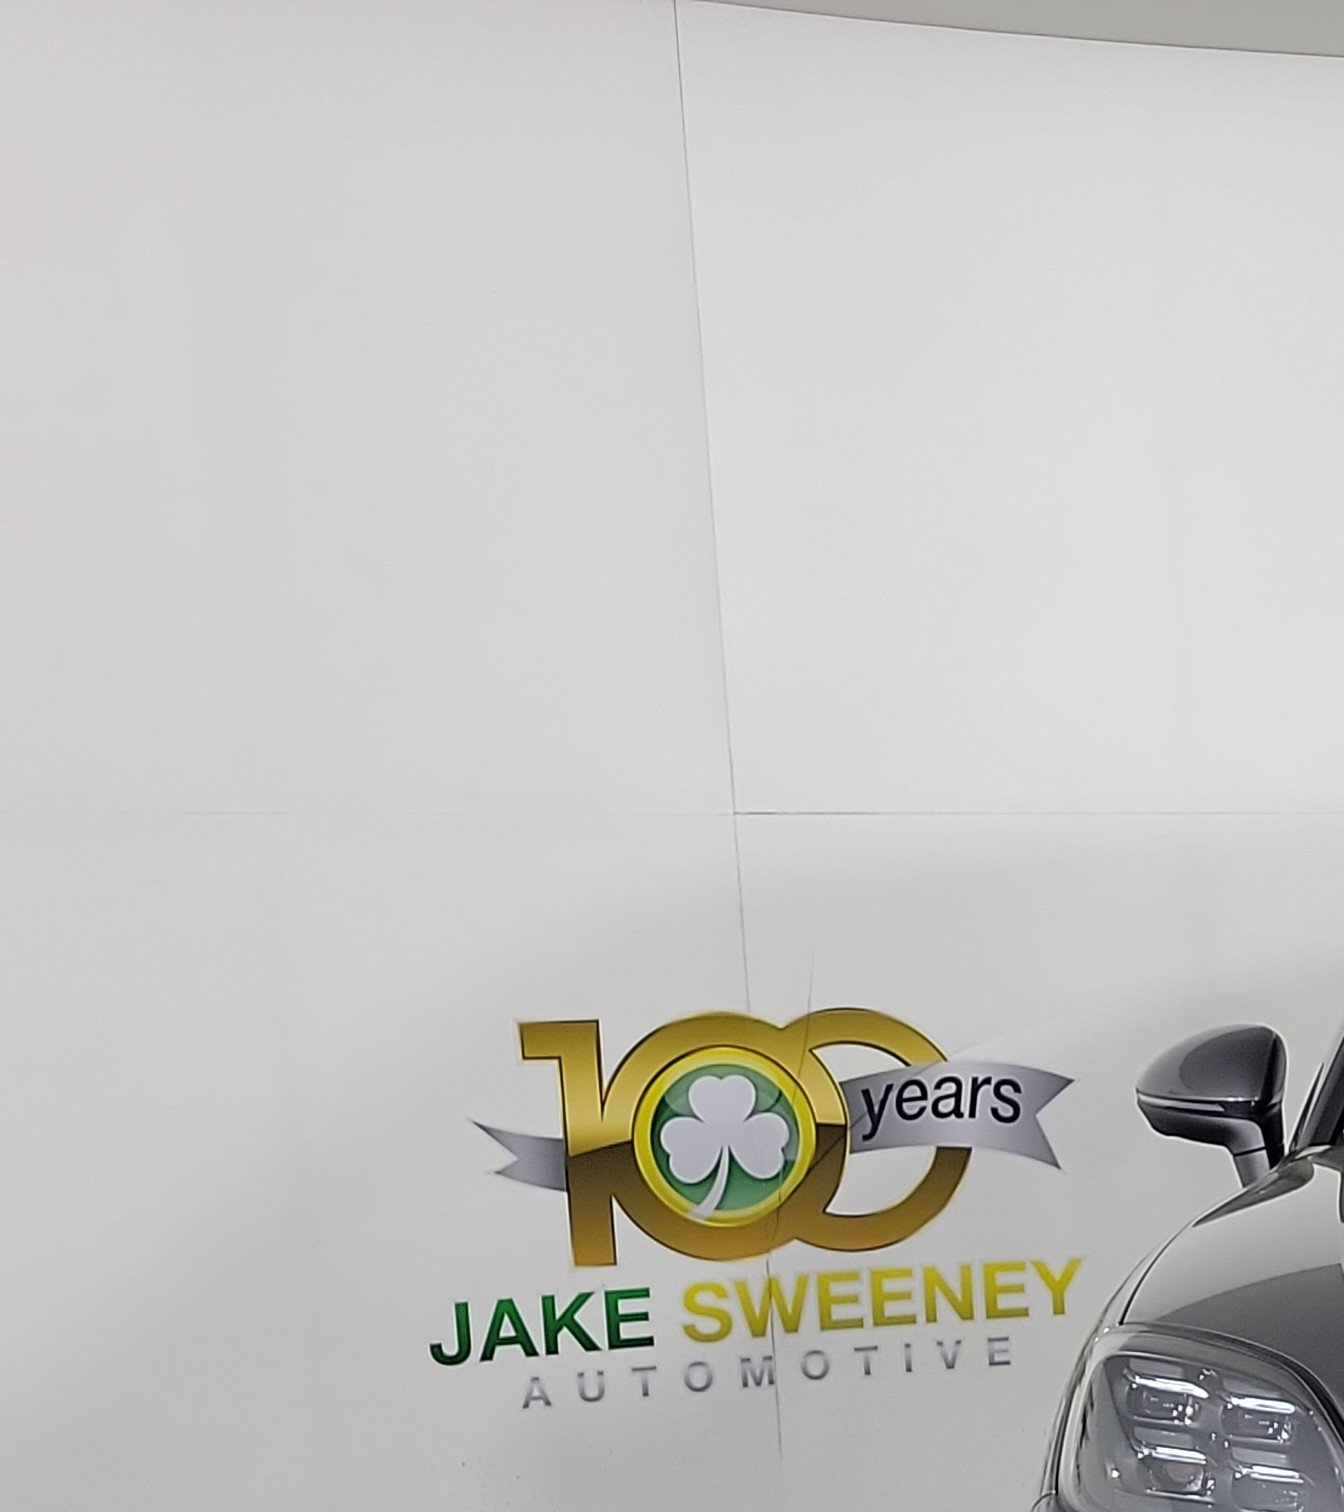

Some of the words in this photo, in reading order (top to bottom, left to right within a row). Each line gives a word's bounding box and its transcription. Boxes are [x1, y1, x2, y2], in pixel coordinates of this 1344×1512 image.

[519, 1008, 972, 1267] 100
[861, 1075, 1022, 1140] years
[430, 1288, 654, 1366] JAKE
[682, 1258, 1084, 1342] SWEENEY
[522, 1336, 1011, 1409] AUTOMOTIVE
